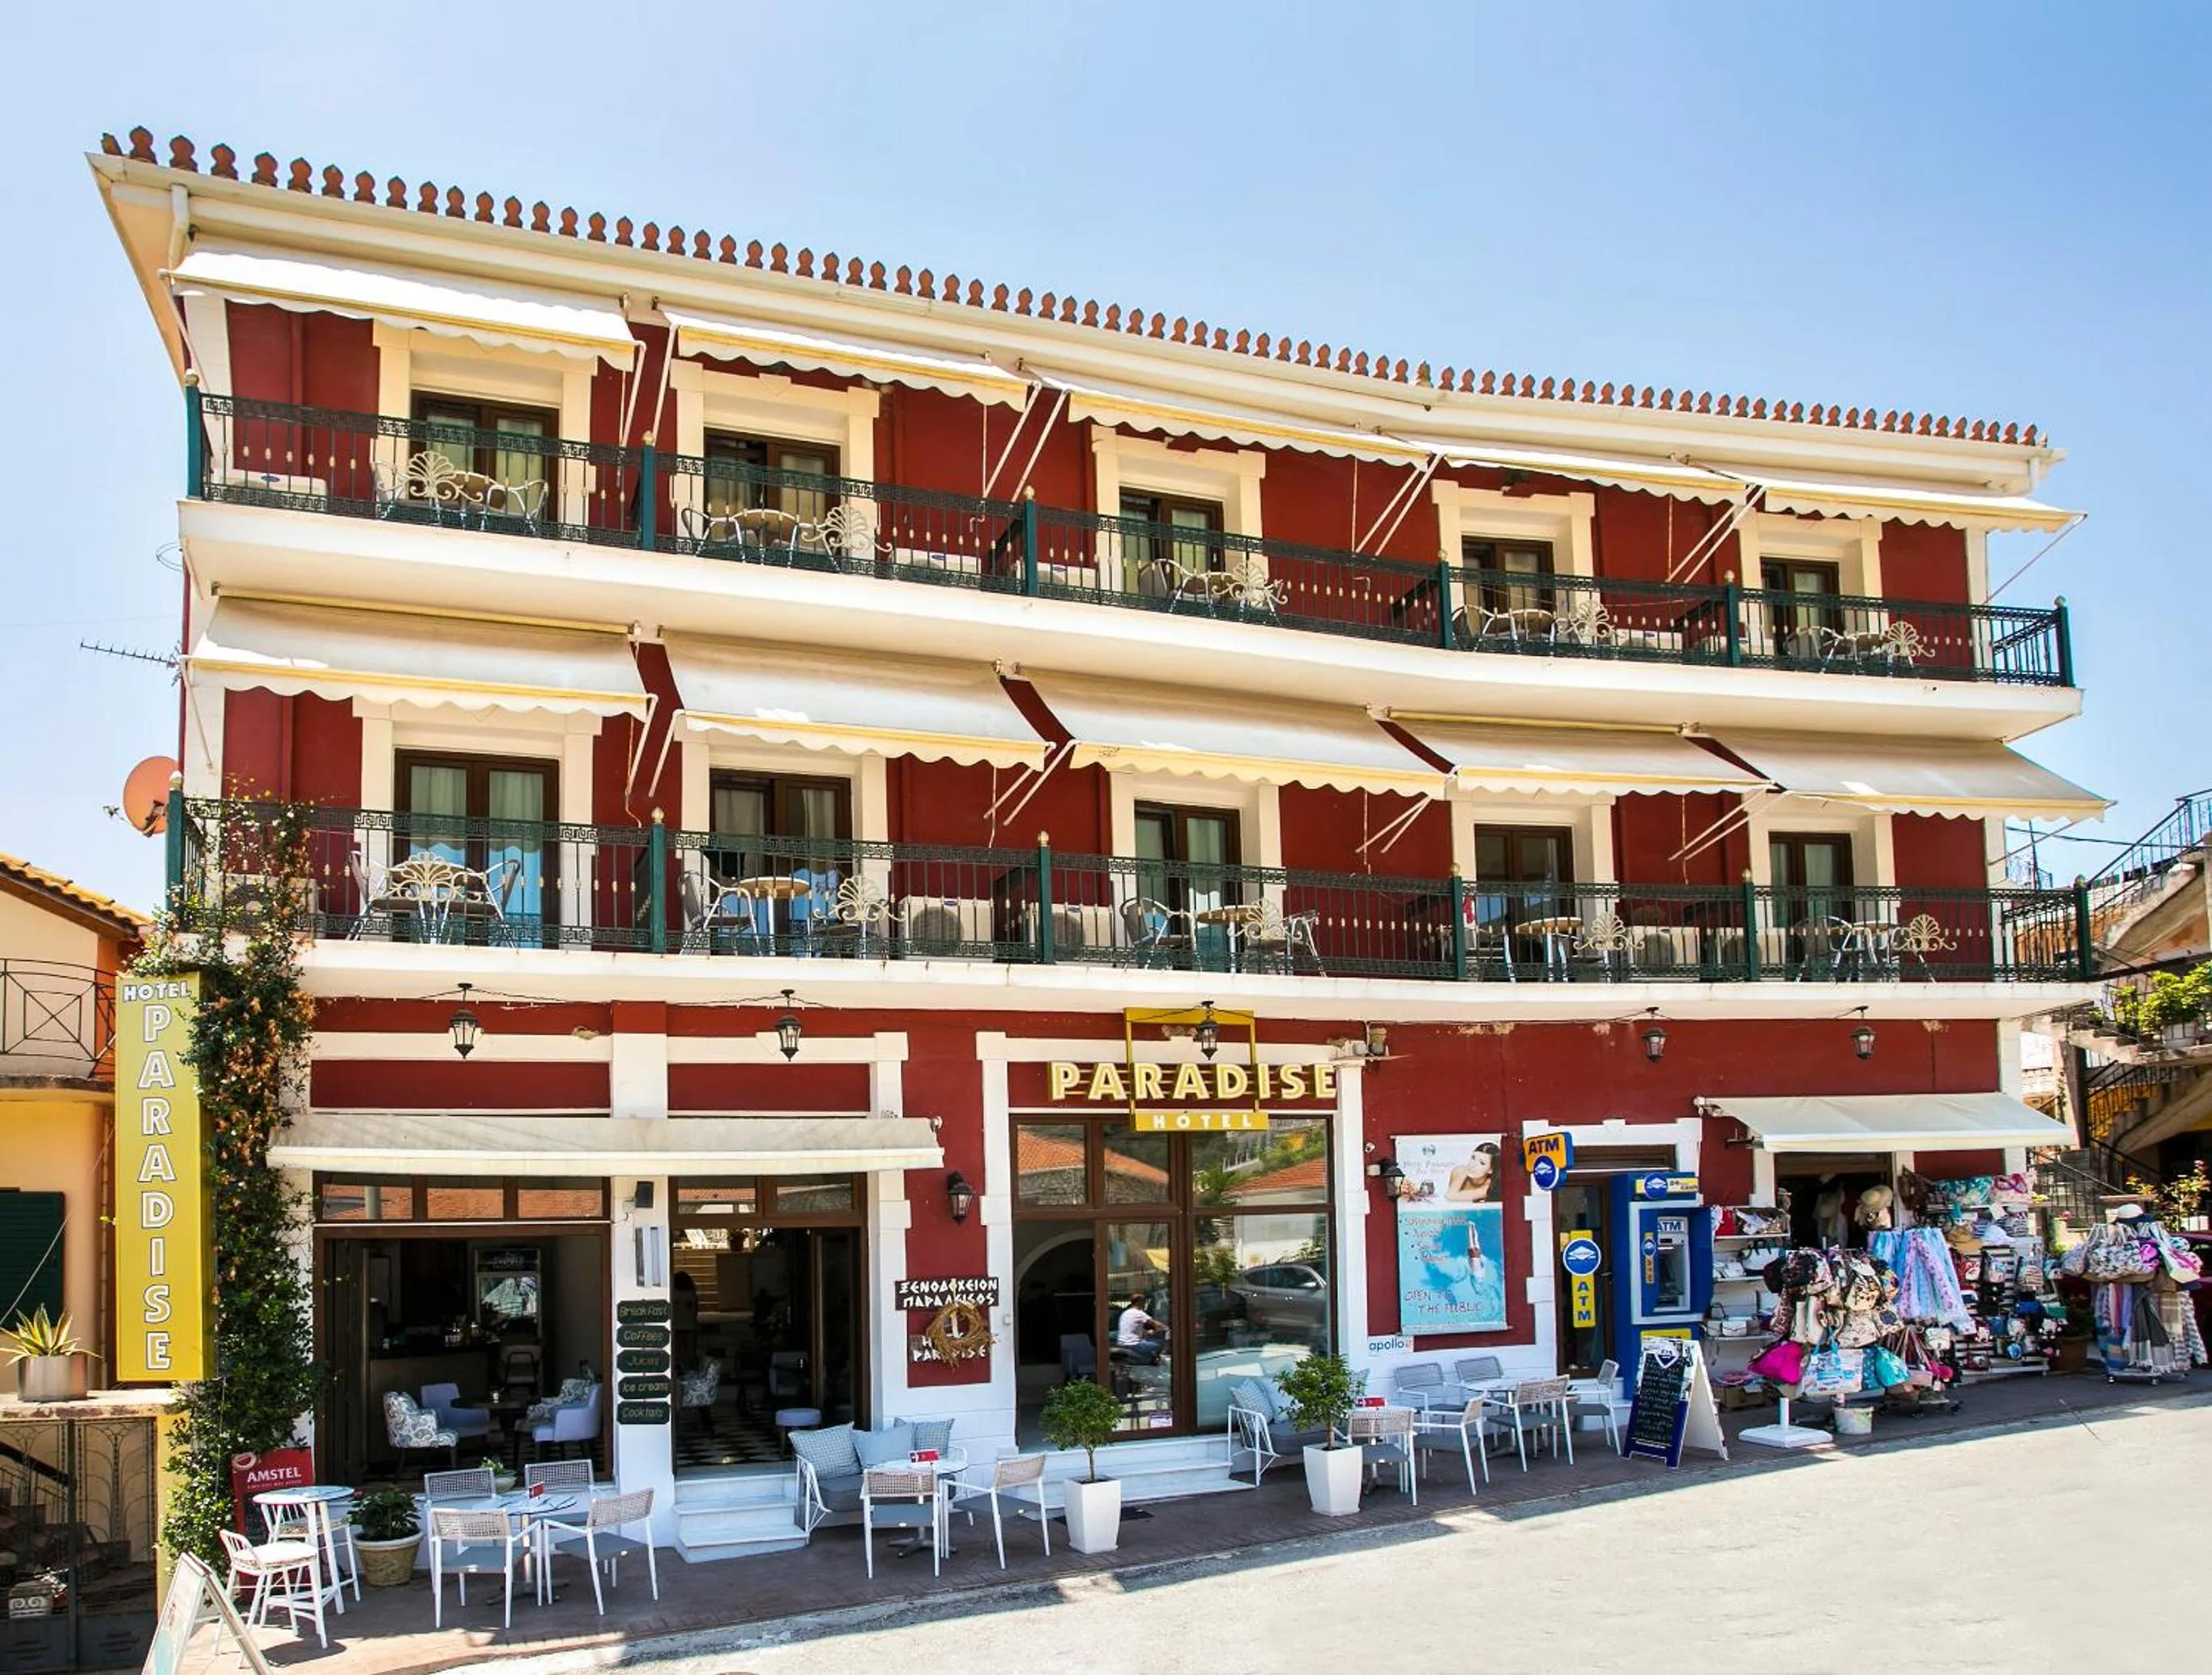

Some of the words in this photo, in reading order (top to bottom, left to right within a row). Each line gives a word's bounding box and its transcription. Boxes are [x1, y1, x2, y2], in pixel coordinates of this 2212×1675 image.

[123, 979, 191, 1002] HOTEL
[1049, 1061, 1337, 1101] PARADISE
[1153, 1114, 1251, 1130] HOTEL
[1528, 1137, 1559, 1155] ATM
[136, 1004, 177, 1370] PARADISE
[1658, 1221, 1681, 1231] ATM
[1404, 1289, 1431, 1302] OPEN
[1577, 1281, 1591, 1321] ATM
[620, 1305, 667, 1318] Breakfast
[1418, 1302, 1439, 1314] THE
[1369, 1337, 1404, 1352] apollo
[622, 1382, 636, 1393] Ice
[247, 1466, 302, 1483] AMSTEL
